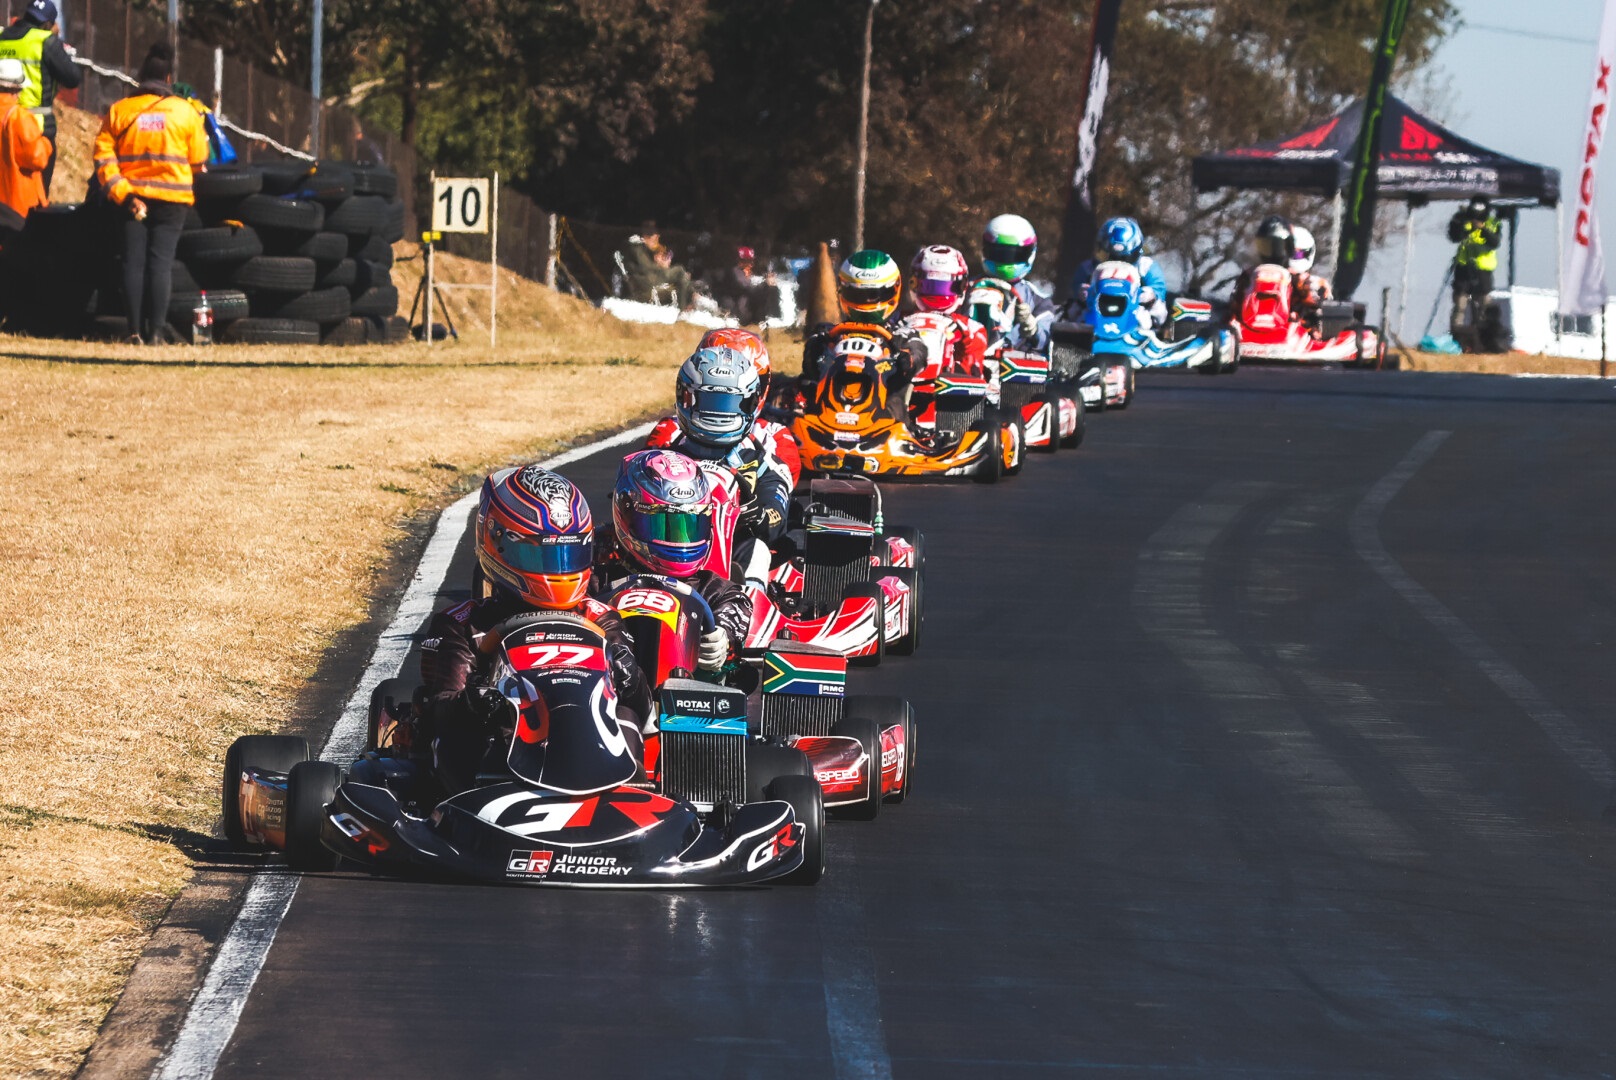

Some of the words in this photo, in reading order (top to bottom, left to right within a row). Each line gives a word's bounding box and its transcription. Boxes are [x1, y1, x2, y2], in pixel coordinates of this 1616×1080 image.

[438, 186, 481, 227] 10
[842, 341, 877, 353] 107
[713, 366, 731, 375] Arai
[673, 487, 692, 496] Arai
[617, 592, 675, 611] 68
[528, 645, 595, 667] 77
[676, 700, 711, 709] ROTAX
[477, 785, 675, 836] GR
[330, 812, 390, 856] GR
[746, 822, 797, 872] GR
[509, 858, 550, 871] GR
[556, 854, 617, 866] JUNIOR
[552, 863, 633, 876] ACADEMY
